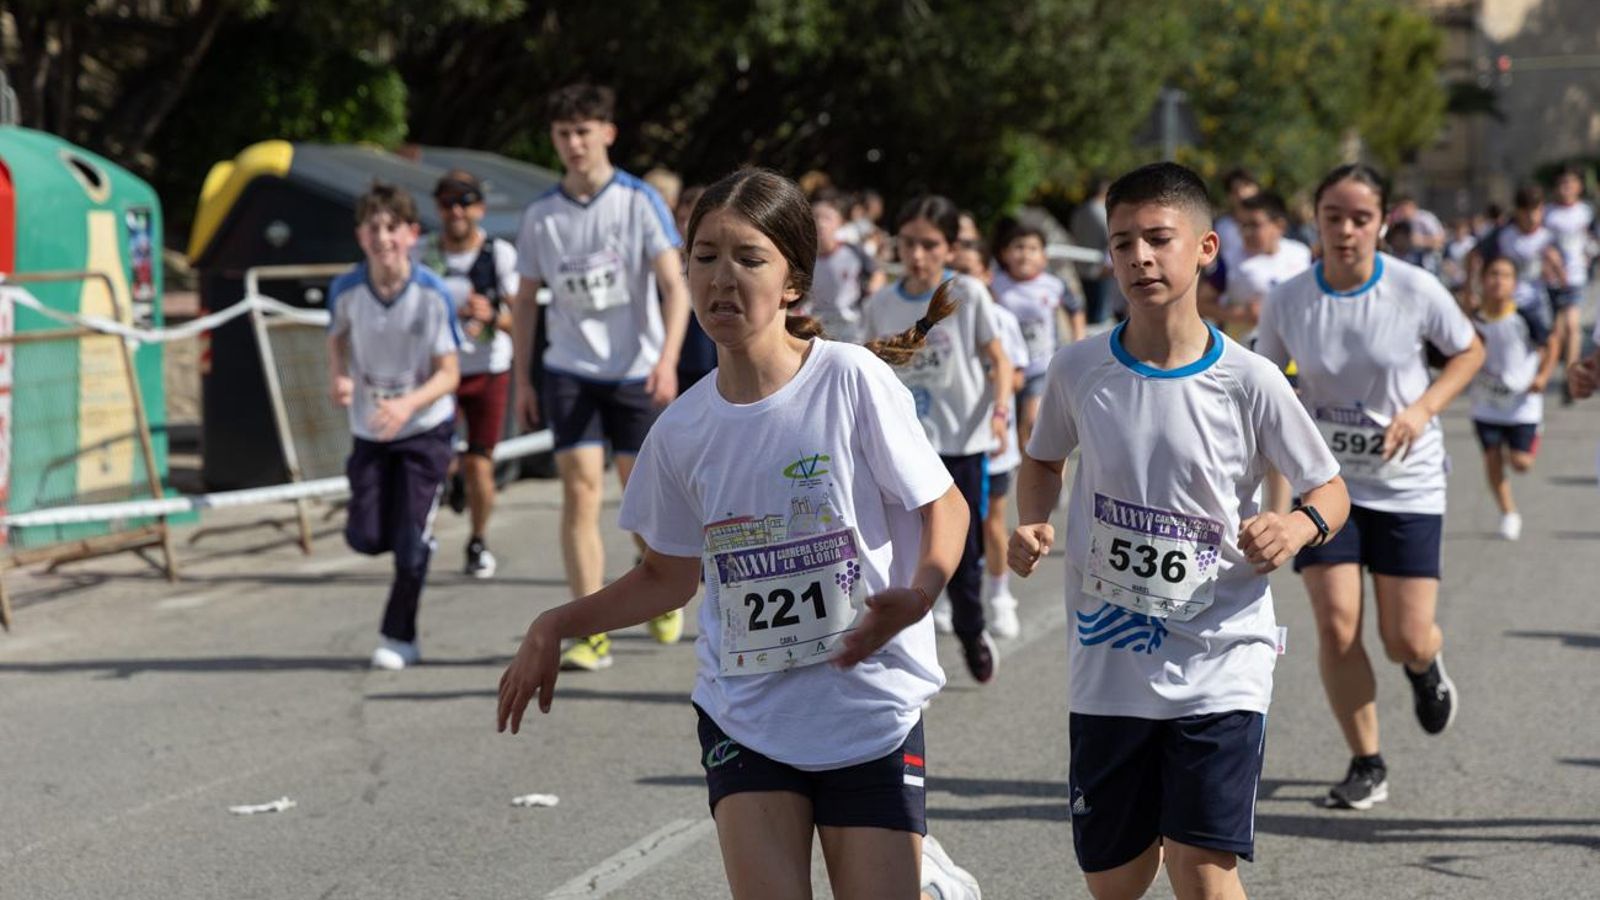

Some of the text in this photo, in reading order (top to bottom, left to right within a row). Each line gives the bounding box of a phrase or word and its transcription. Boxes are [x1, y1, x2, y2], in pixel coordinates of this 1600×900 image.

[1332, 431, 1385, 455] 592
[1159, 524, 1170, 535] LA
[777, 545, 812, 561] CARRERA
[812, 534, 849, 551] ESCOLAR
[783, 548, 842, 570] LA GLORIA
[1108, 538, 1187, 583] 536
[744, 581, 827, 631] 221
